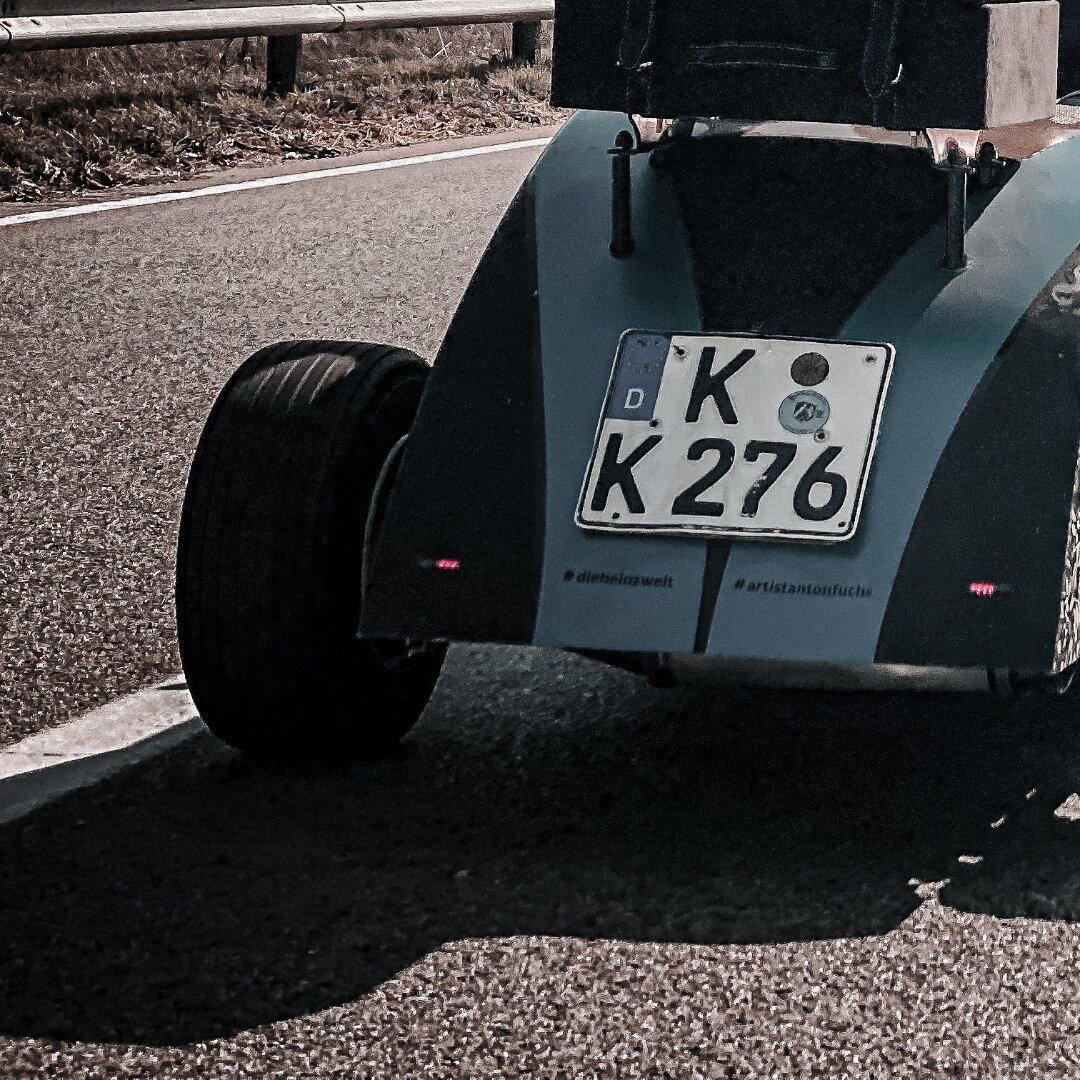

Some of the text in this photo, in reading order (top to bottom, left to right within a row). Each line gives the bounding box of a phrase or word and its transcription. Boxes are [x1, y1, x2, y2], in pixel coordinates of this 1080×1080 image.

[624, 388, 645, 409] D
[685, 346, 756, 425] K
[590, 432, 848, 521] K 276
